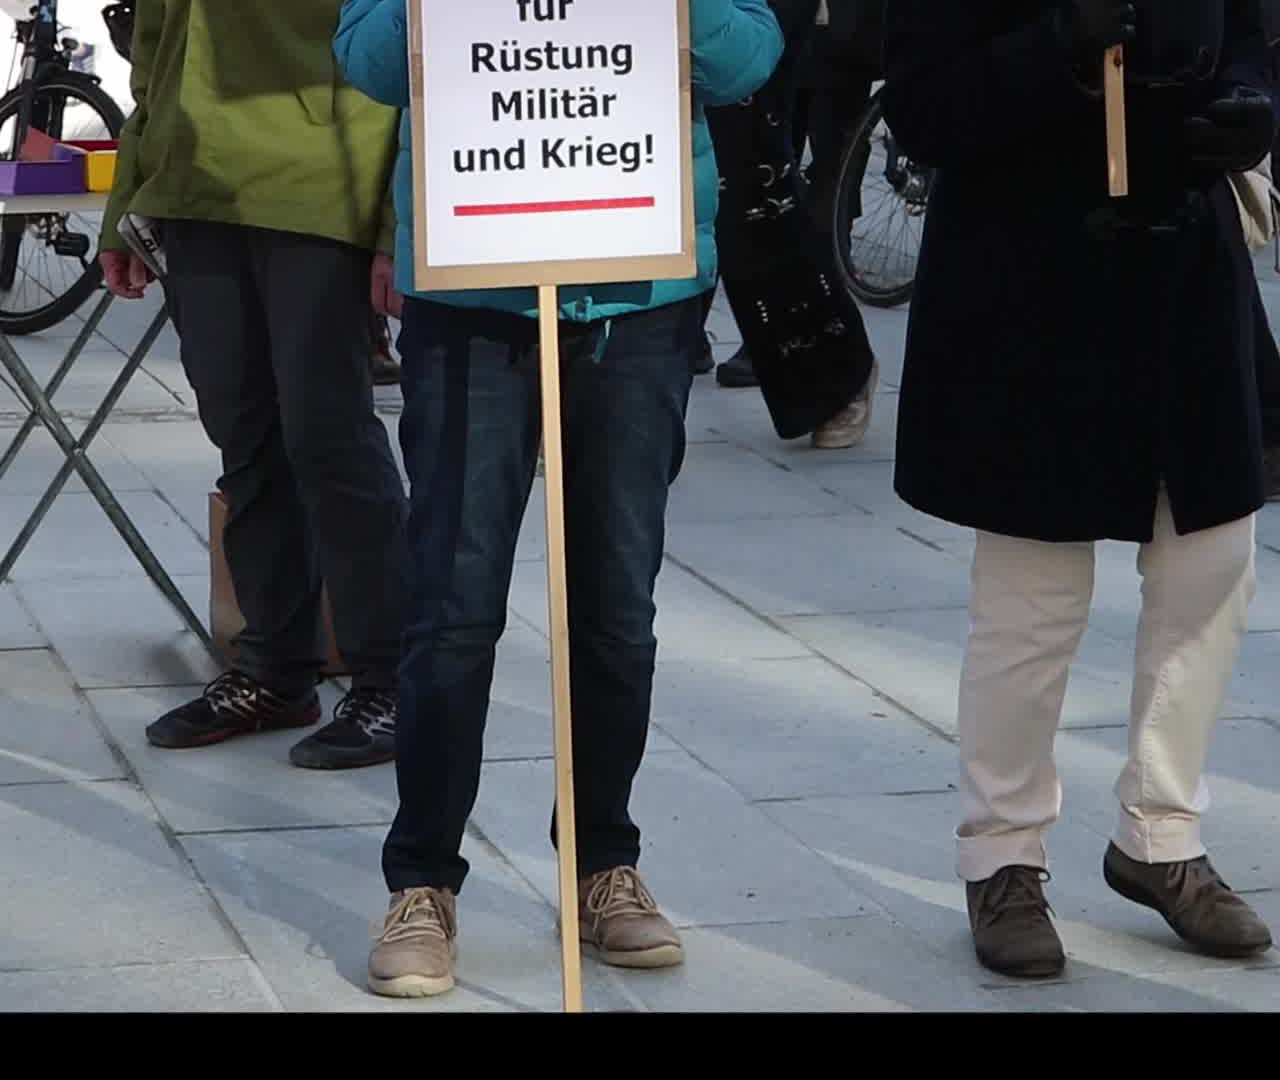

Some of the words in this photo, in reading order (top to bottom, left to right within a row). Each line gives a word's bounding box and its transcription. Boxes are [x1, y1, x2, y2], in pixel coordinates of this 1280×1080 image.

[471, 40, 634, 75] Rüstung
[491, 87, 617, 121] Militär
[453, 138, 526, 172] und
[542, 134, 654, 173] Krieg!
